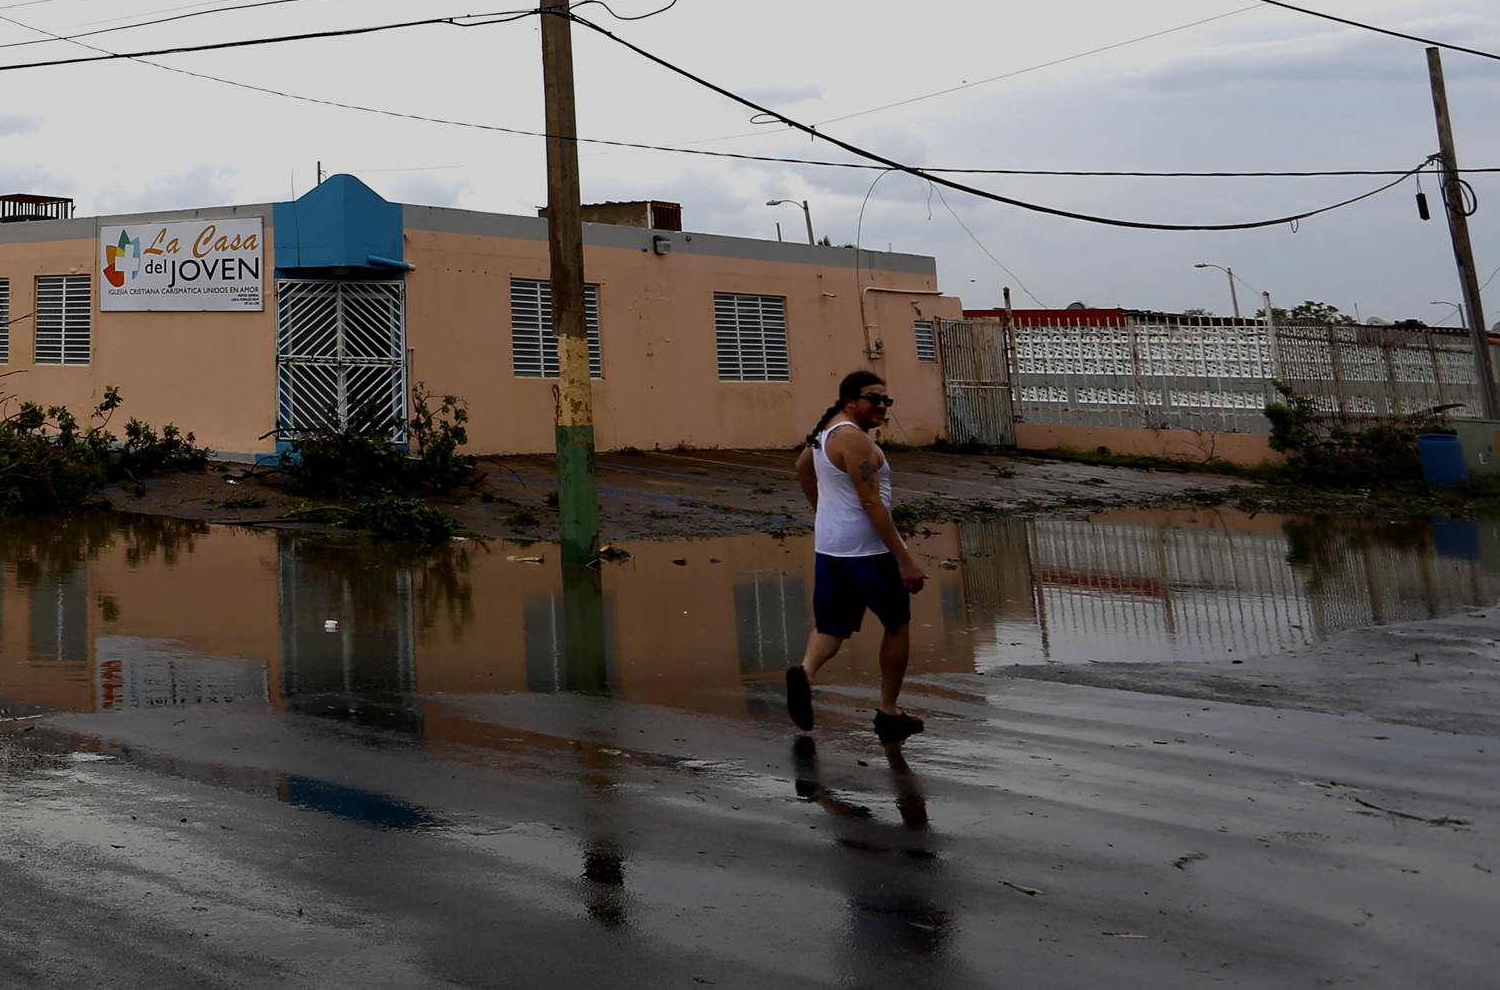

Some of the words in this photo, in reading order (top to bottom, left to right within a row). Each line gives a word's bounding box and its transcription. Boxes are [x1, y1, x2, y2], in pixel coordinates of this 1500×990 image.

[143, 227, 181, 255] La
[193, 224, 260, 258] Casa
[145, 259, 167, 274] del
[168, 257, 259, 288] JOVEN
